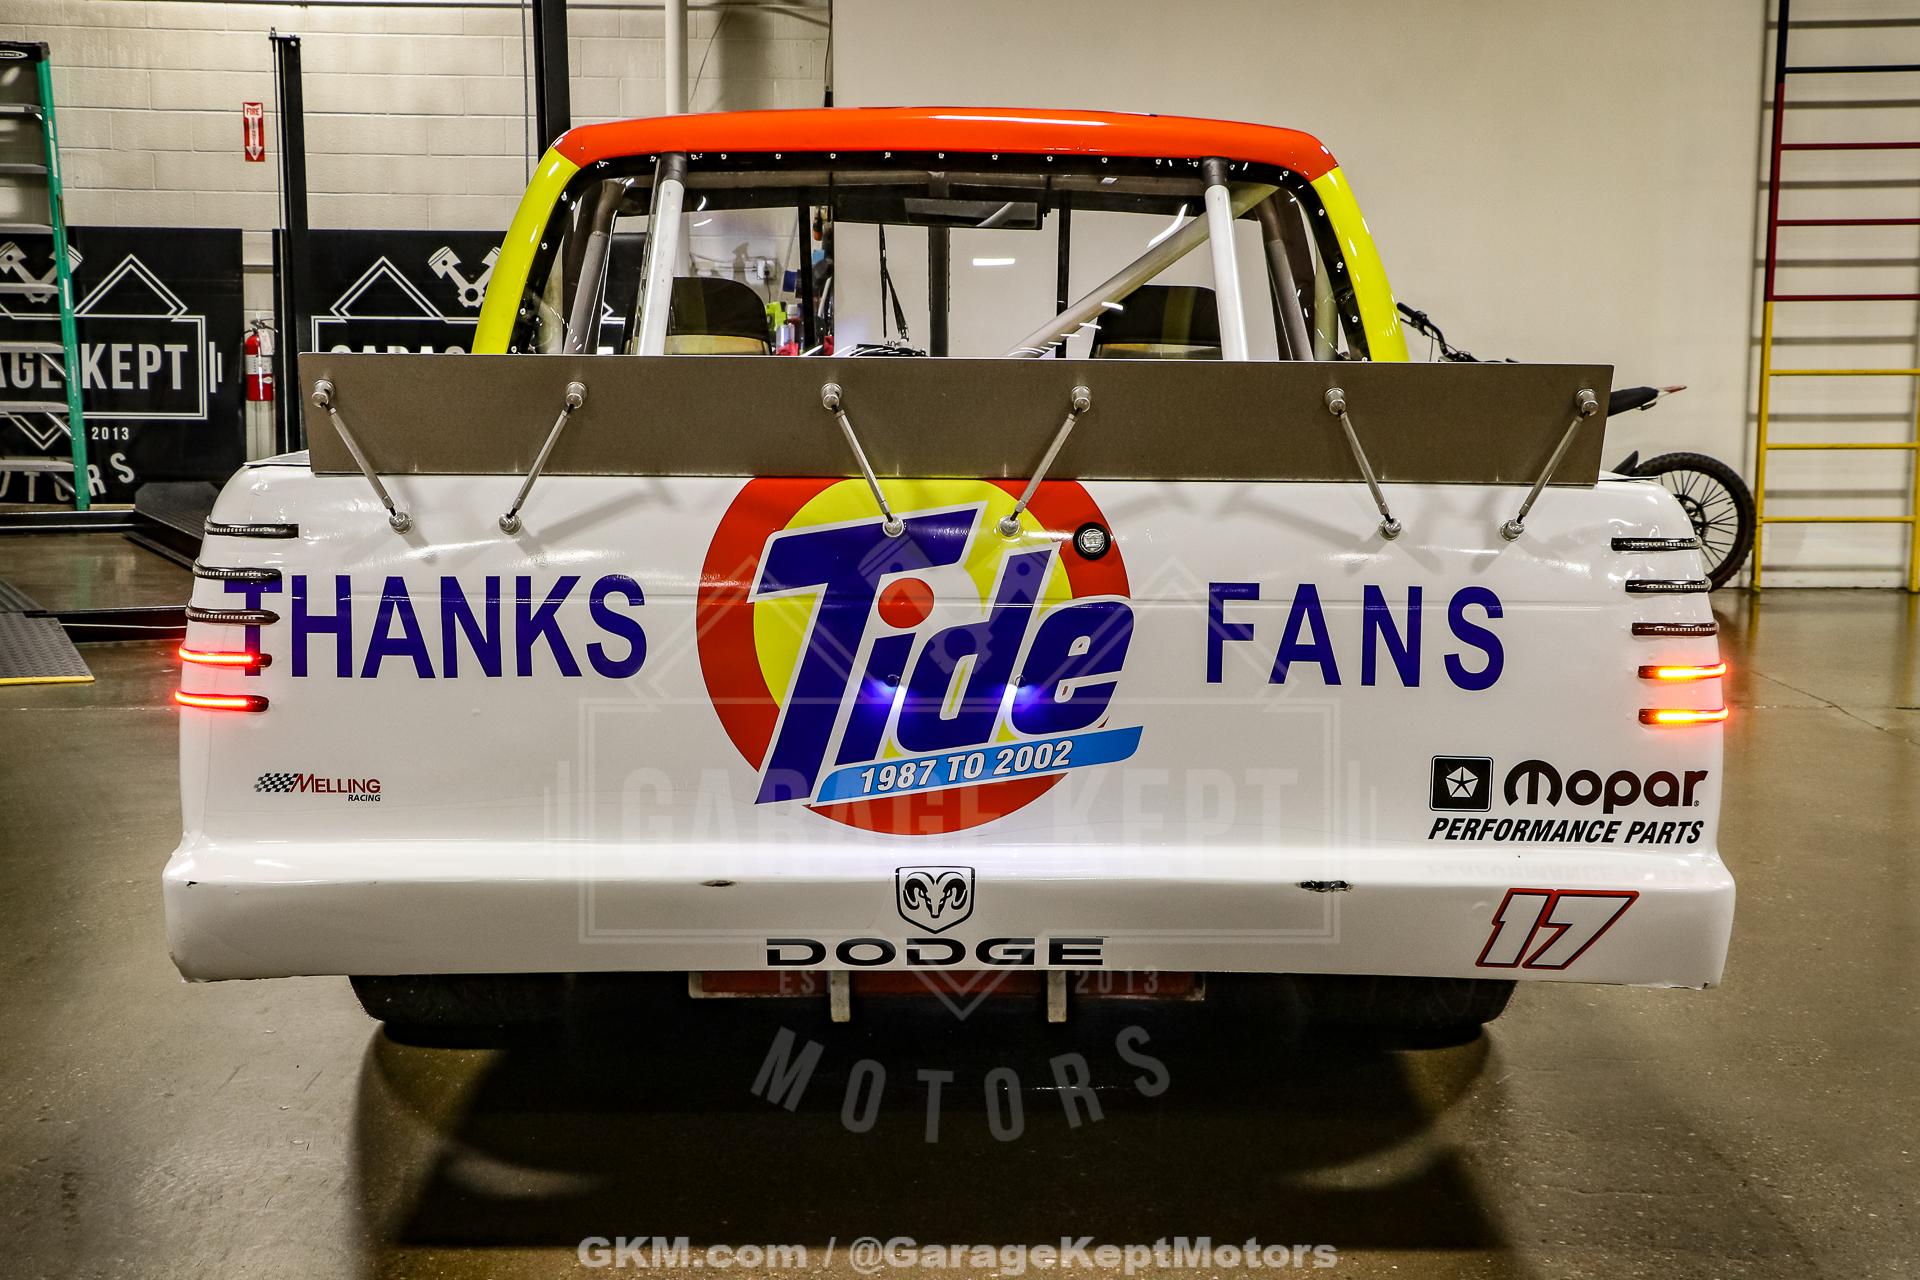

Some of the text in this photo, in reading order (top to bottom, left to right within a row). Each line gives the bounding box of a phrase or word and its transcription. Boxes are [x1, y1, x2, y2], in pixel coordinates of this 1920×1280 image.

[81, 344, 188, 390] KEPT
[91, 427, 130, 440] 2013
[224, 573, 648, 679] THANKS
[1206, 582, 1505, 691] FANS
[750, 502, 1137, 806] Tide
[861, 740, 1073, 793] 1987 TO 2002
[347, 794, 381, 802] RACING
[1428, 818, 1704, 844] PERFORMANCE PARTS
[766, 938, 1103, 967] DODGE
[1475, 888, 1640, 970] 17
